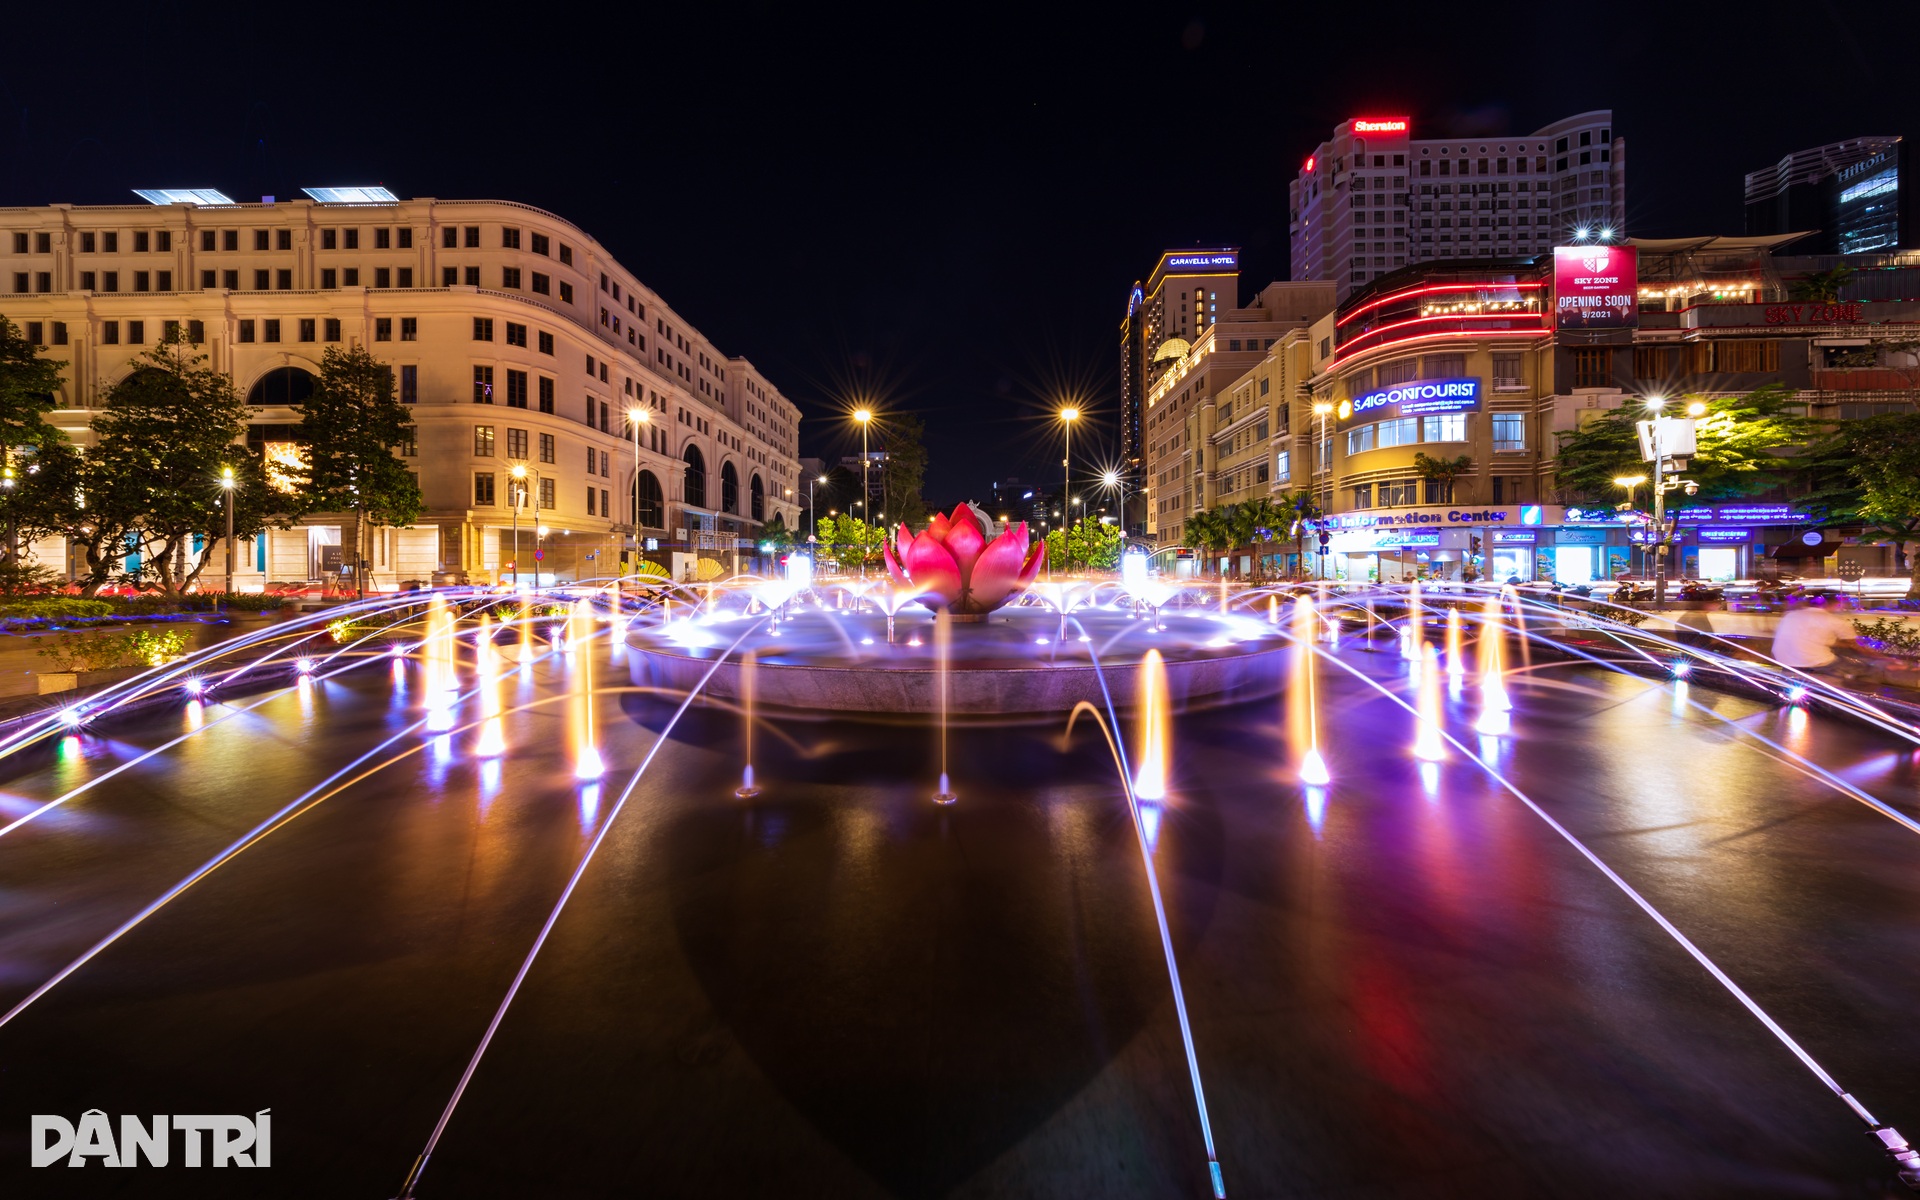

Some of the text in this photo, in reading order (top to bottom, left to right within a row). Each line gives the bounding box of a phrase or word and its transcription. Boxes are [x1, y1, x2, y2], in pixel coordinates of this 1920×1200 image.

[1355, 121, 1405, 132] Sheraton
[1838, 153, 1885, 182] Hilton
[1170, 257, 1235, 266] CARAVELLE HOTEL
[1559, 295, 1631, 308] OPENING SOON
[1765, 304, 1864, 323] SKY ZONE
[1353, 383, 1475, 412] SAIGONTOURIST
[1341, 512, 1441, 527] Information
[1447, 510, 1507, 522] Center
